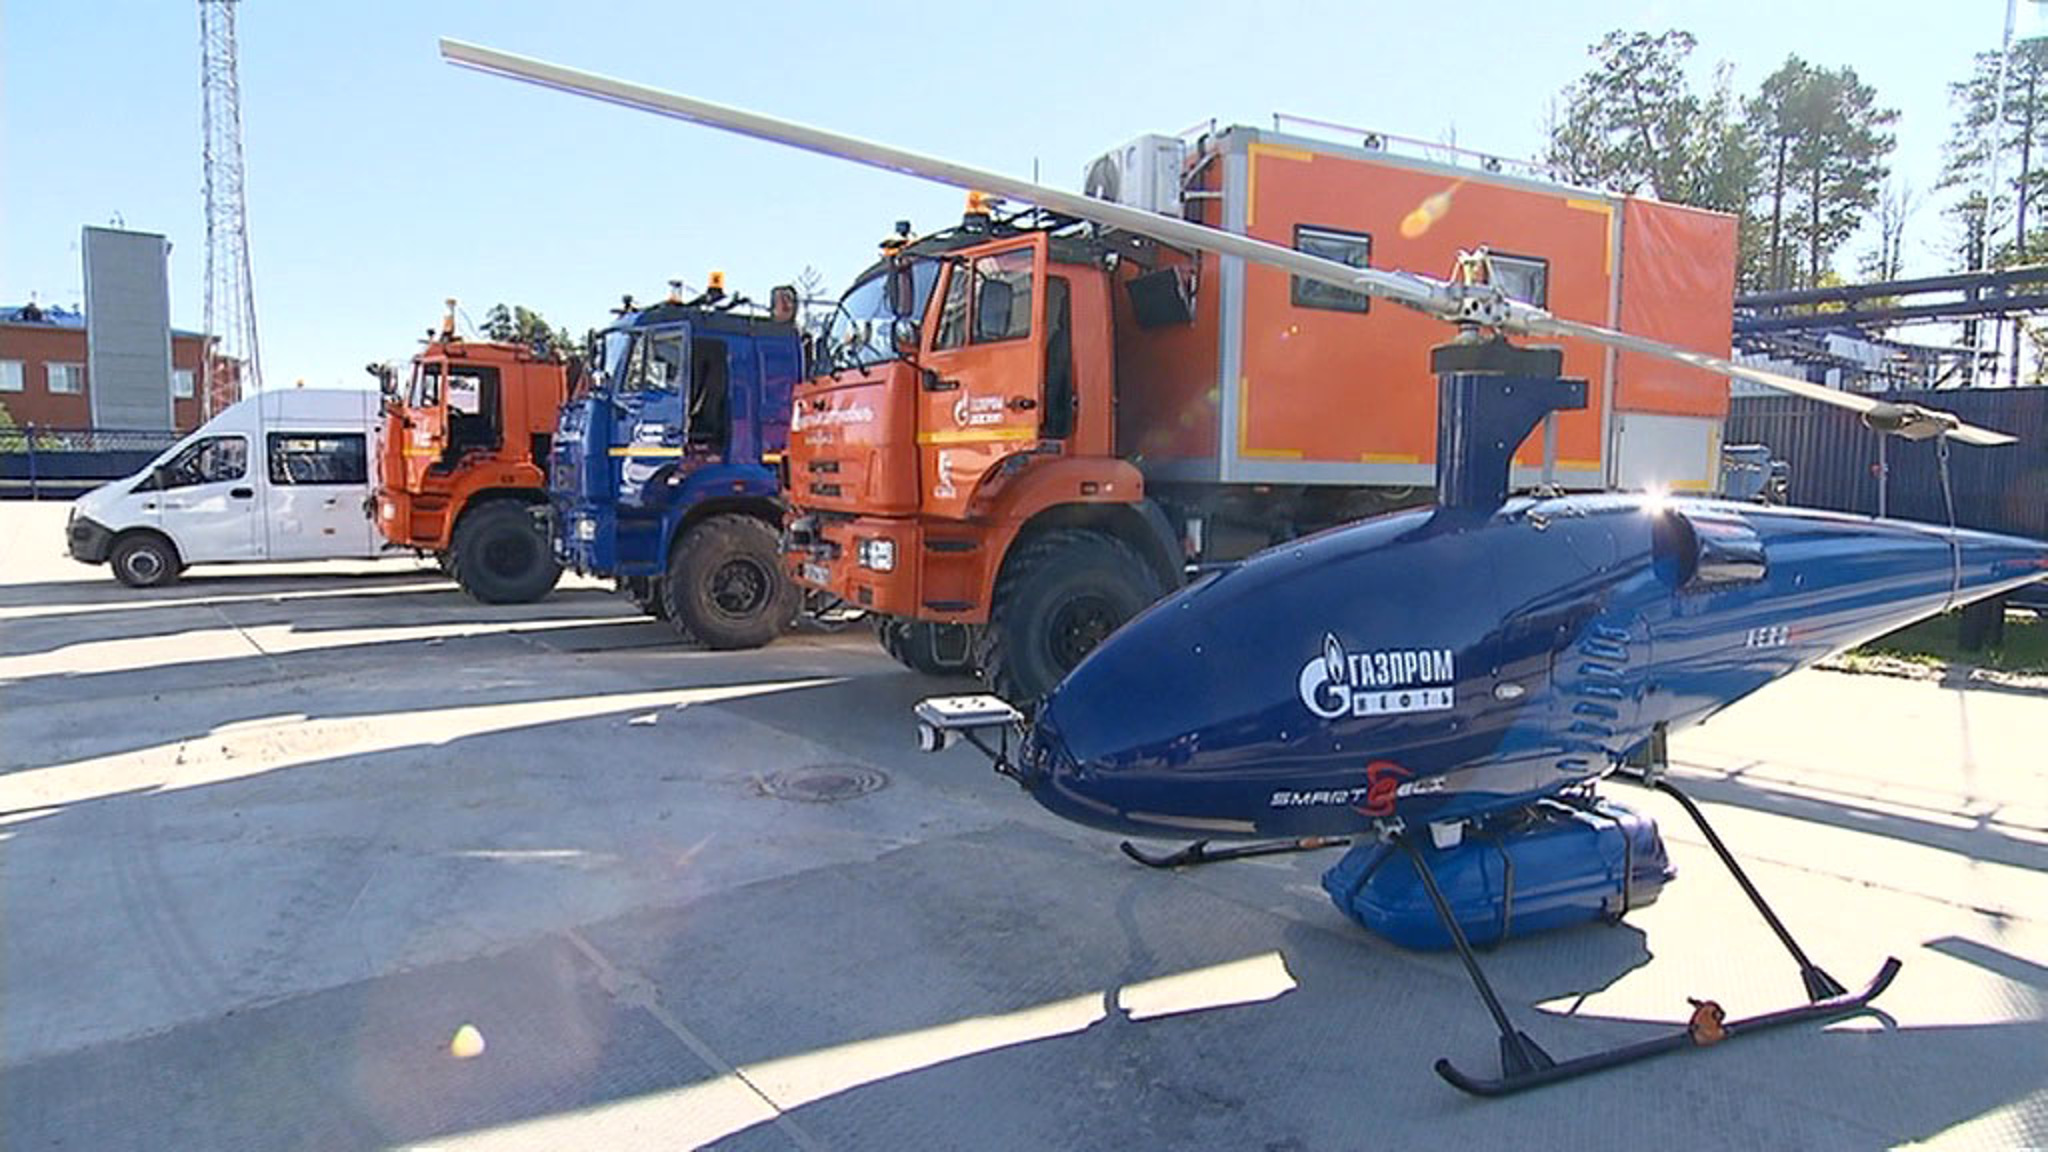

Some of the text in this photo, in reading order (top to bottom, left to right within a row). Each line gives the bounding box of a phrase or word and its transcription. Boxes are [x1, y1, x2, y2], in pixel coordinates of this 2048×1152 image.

[1347, 649, 1454, 687] ГАЗПРОМ
[1355, 690, 1451, 712] НЕФТЬ
[1269, 787, 1367, 807] SMART
